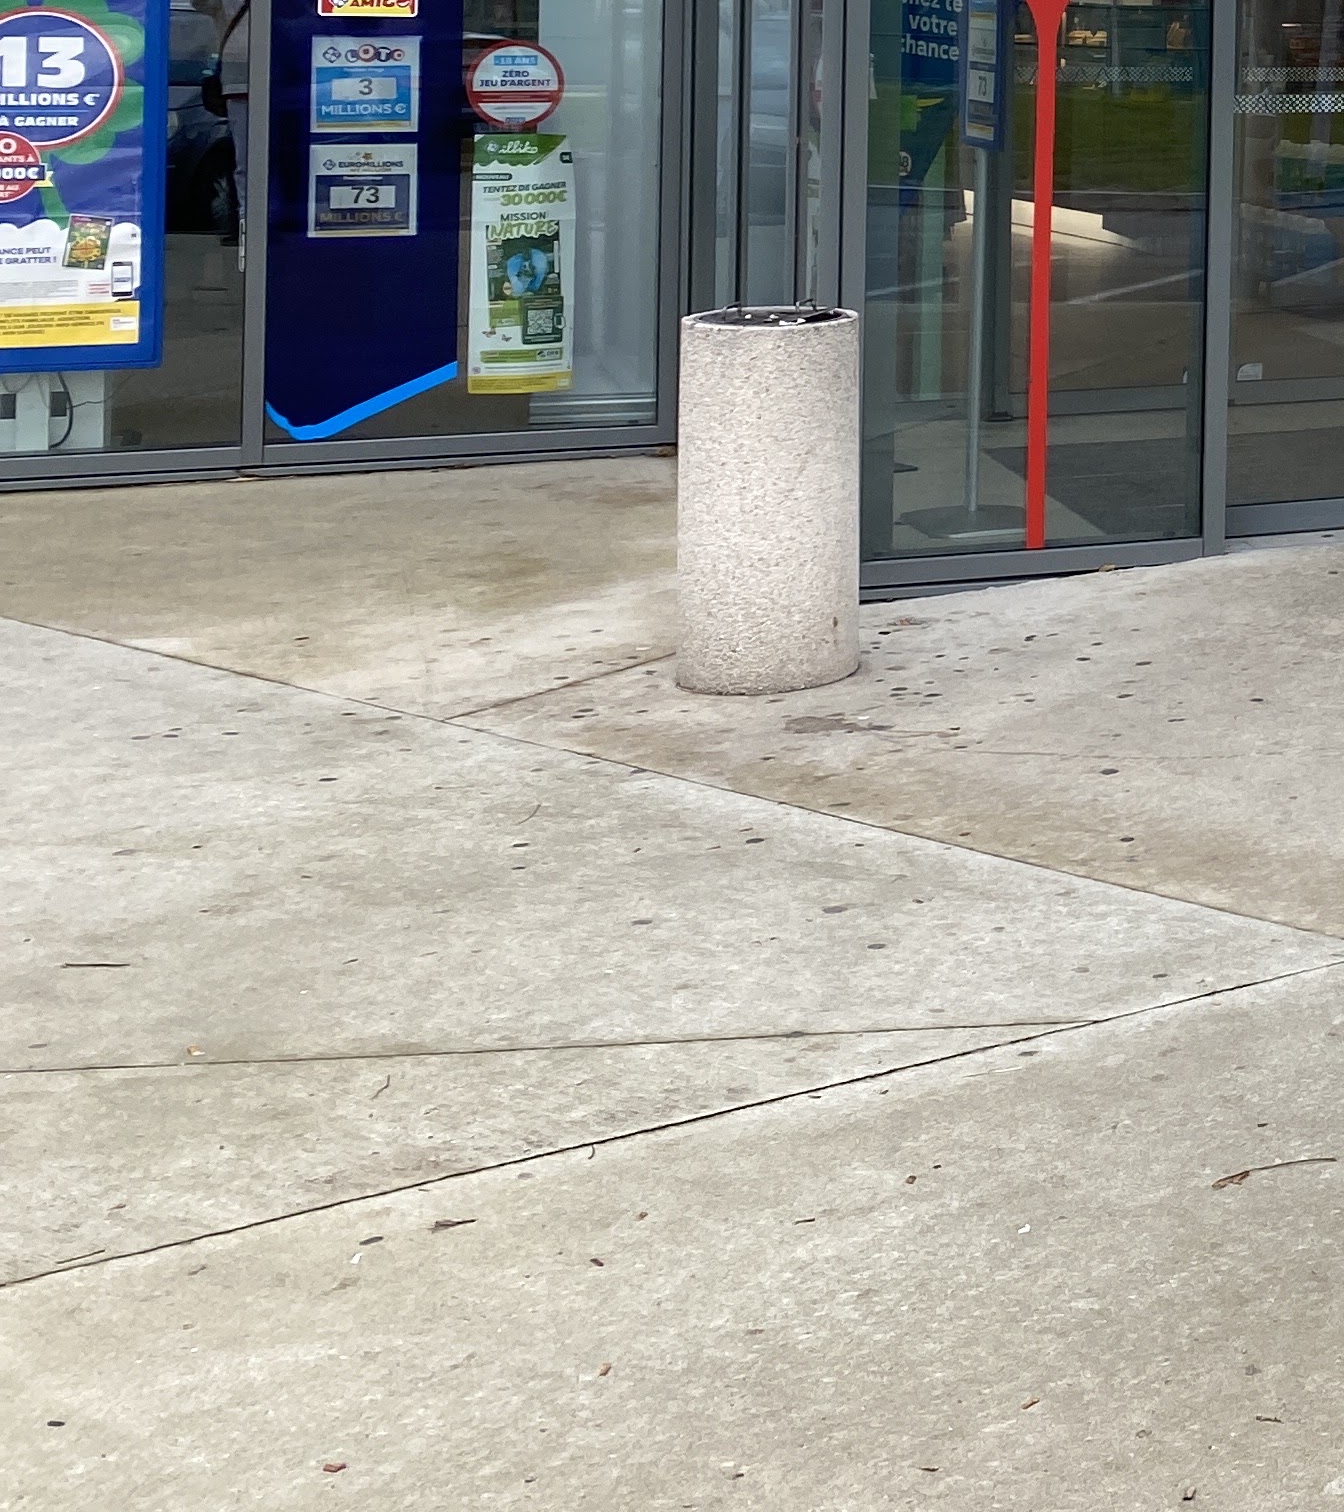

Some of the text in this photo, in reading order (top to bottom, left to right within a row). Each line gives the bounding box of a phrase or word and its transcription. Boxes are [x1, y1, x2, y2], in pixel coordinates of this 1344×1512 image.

[908, 13, 959, 36] votre
[344, 44, 405, 63] LOTO
[0, 36, 86, 89] 13
[502, 70, 530, 78] ZÉRO
[358, 78, 374, 96] 3
[480, 79, 552, 88] JEU D'ARGENT
[83, 93, 100, 106] €
[321, 103, 407, 116] MILLIONS €
[14, 116, 80, 127] GAGNER
[0, 167, 39, 180] 00€
[350, 185, 380, 204] 73
[500, 211, 547, 222] MISSION
[488, 220, 560, 240] NATURE
